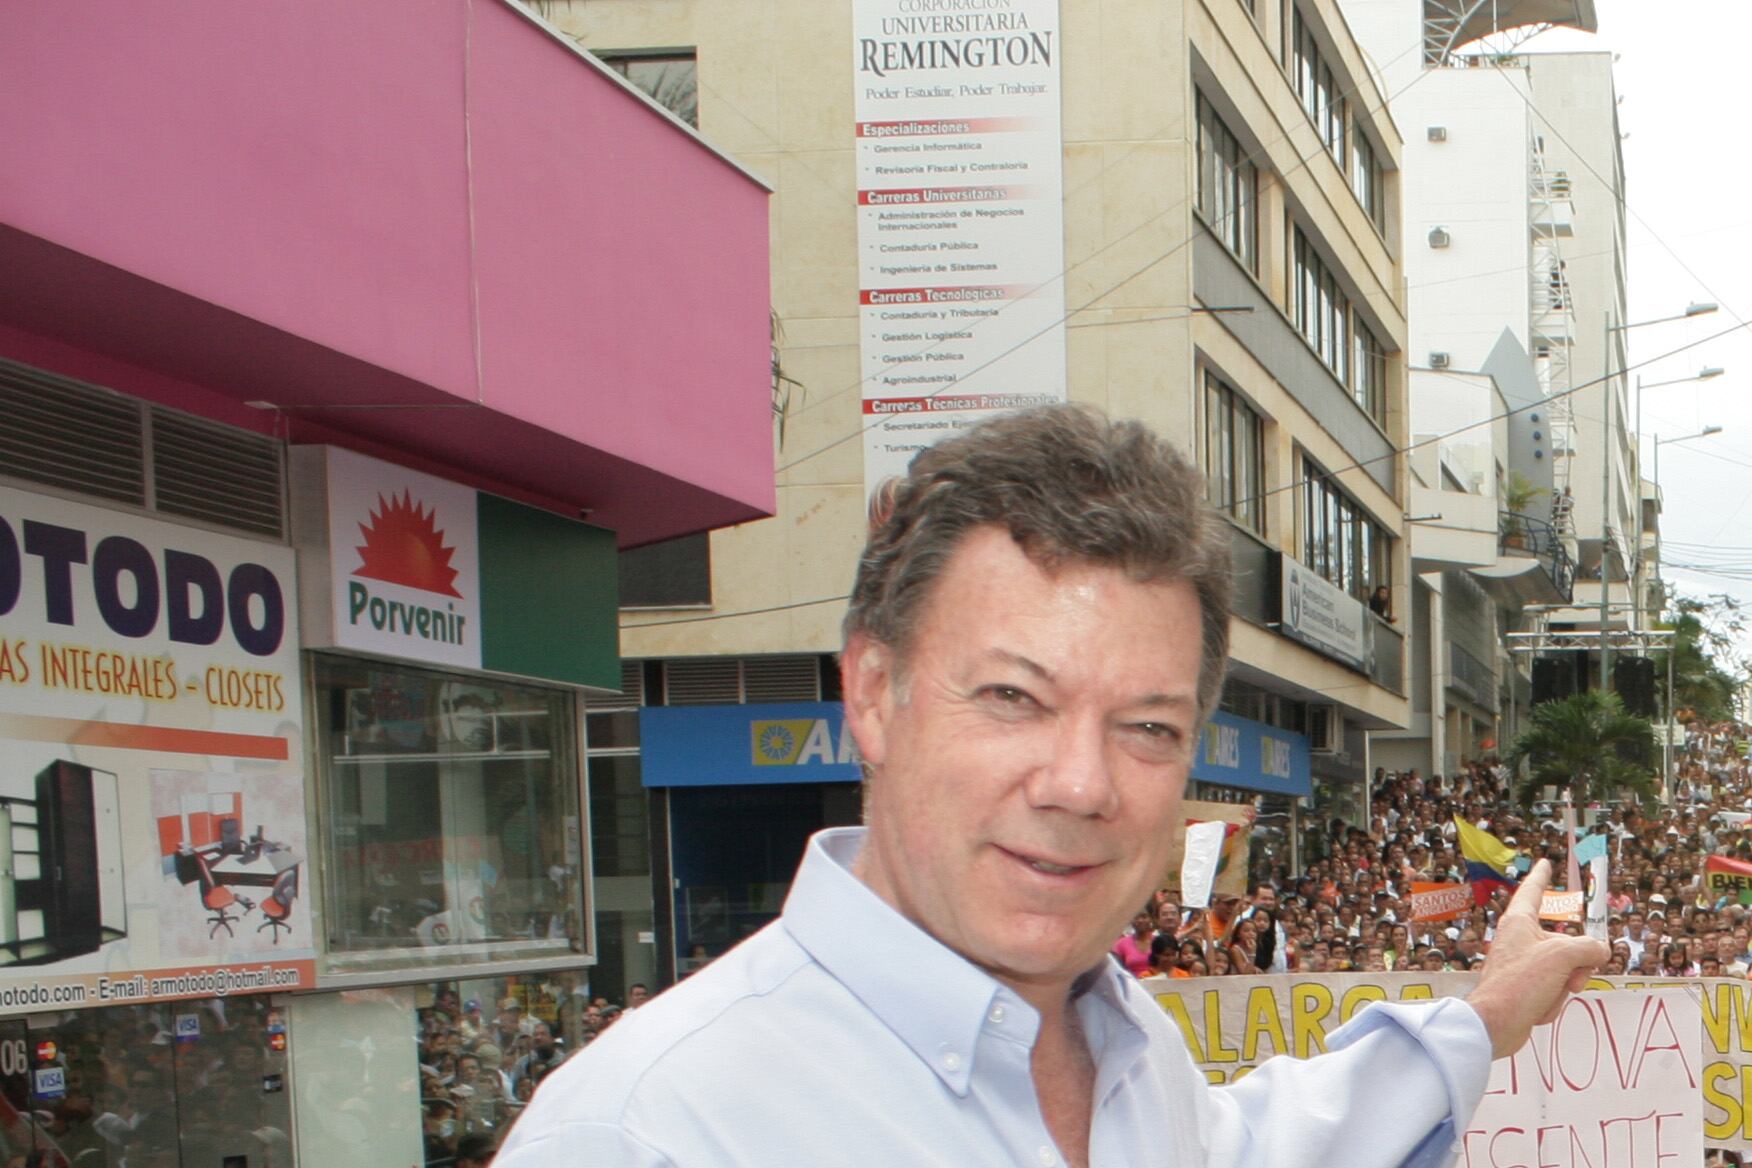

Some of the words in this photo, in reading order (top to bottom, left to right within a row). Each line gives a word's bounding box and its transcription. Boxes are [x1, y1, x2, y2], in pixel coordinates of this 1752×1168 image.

[882, 12, 1029, 35] UNIVERSITARIA
[860, 31, 1052, 77] REMINGTON
[865, 87, 899, 100] Poder
[959, 83, 993, 96] Poder
[863, 121, 970, 138] Especializaciones
[874, 143, 920, 153] Gerencia
[927, 163, 958, 173] Fiscal
[867, 191, 919, 204] Carreras
[923, 188, 1007, 202] Universitarias
[960, 209, 972, 218] de
[975, 207, 1024, 218] Negocios
[878, 221, 957, 232] Internacionales
[934, 264, 946, 272] de
[950, 262, 997, 272] Sistemas
[869, 291, 921, 304] Carreras
[883, 374, 957, 386] Agroindustrial
[872, 400, 923, 413] Carreras
[883, 421, 949, 431] Secretariado
[349, 580, 466, 646] Porvenir
[41, 644, 177, 700] INTEGRALES
[205, 667, 284, 712] CLOSETS
[0, 983, 85, 1006] otodo.com
[100, 975, 149, 999] E-mail:
[151, 968, 299, 995] armotodo@hotmail.com
[179, 1018, 198, 1032] VISA
[1484, 994, 1697, 1096] NOVA
[38, 1073, 64, 1088] VISA
